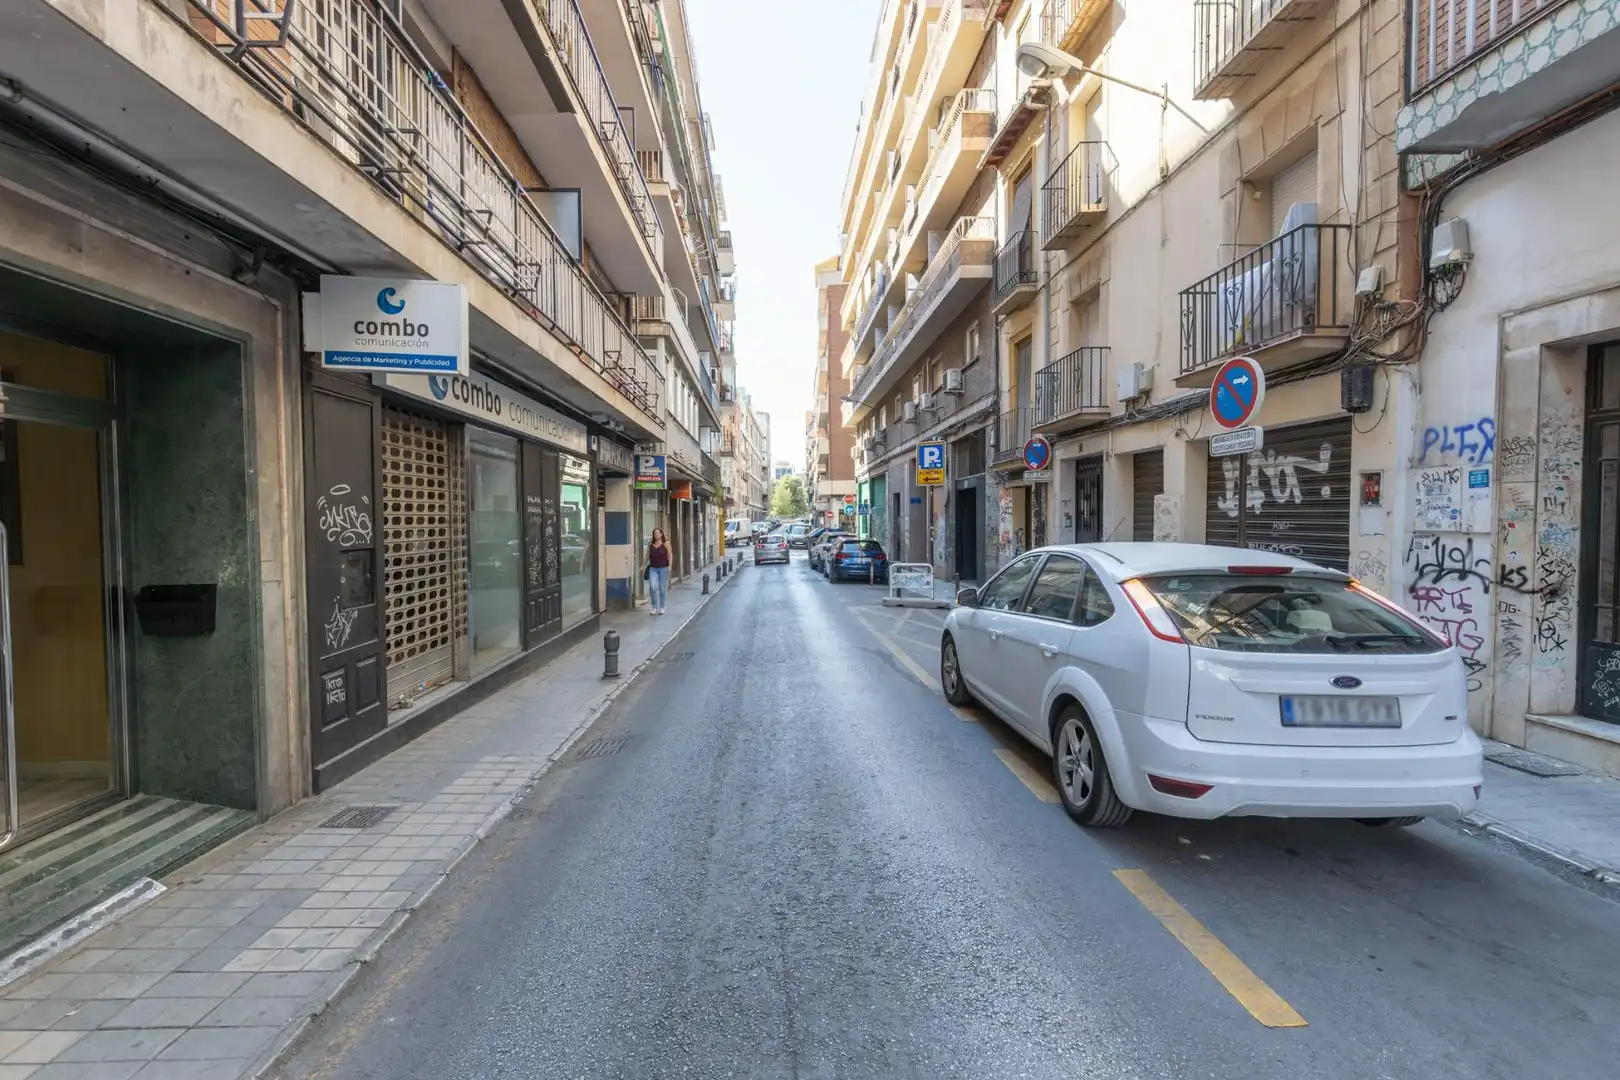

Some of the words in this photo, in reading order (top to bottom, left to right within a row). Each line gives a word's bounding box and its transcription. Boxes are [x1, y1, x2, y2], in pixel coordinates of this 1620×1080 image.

[353, 318, 429, 337] combo
[354, 338, 429, 349] comunicación
[333, 355, 361, 363] Agencia
[373, 357, 407, 365] Marketing
[414, 358, 450, 366] Publicidad
[452, 376, 502, 416] combo
[509, 401, 574, 443] comunicación
